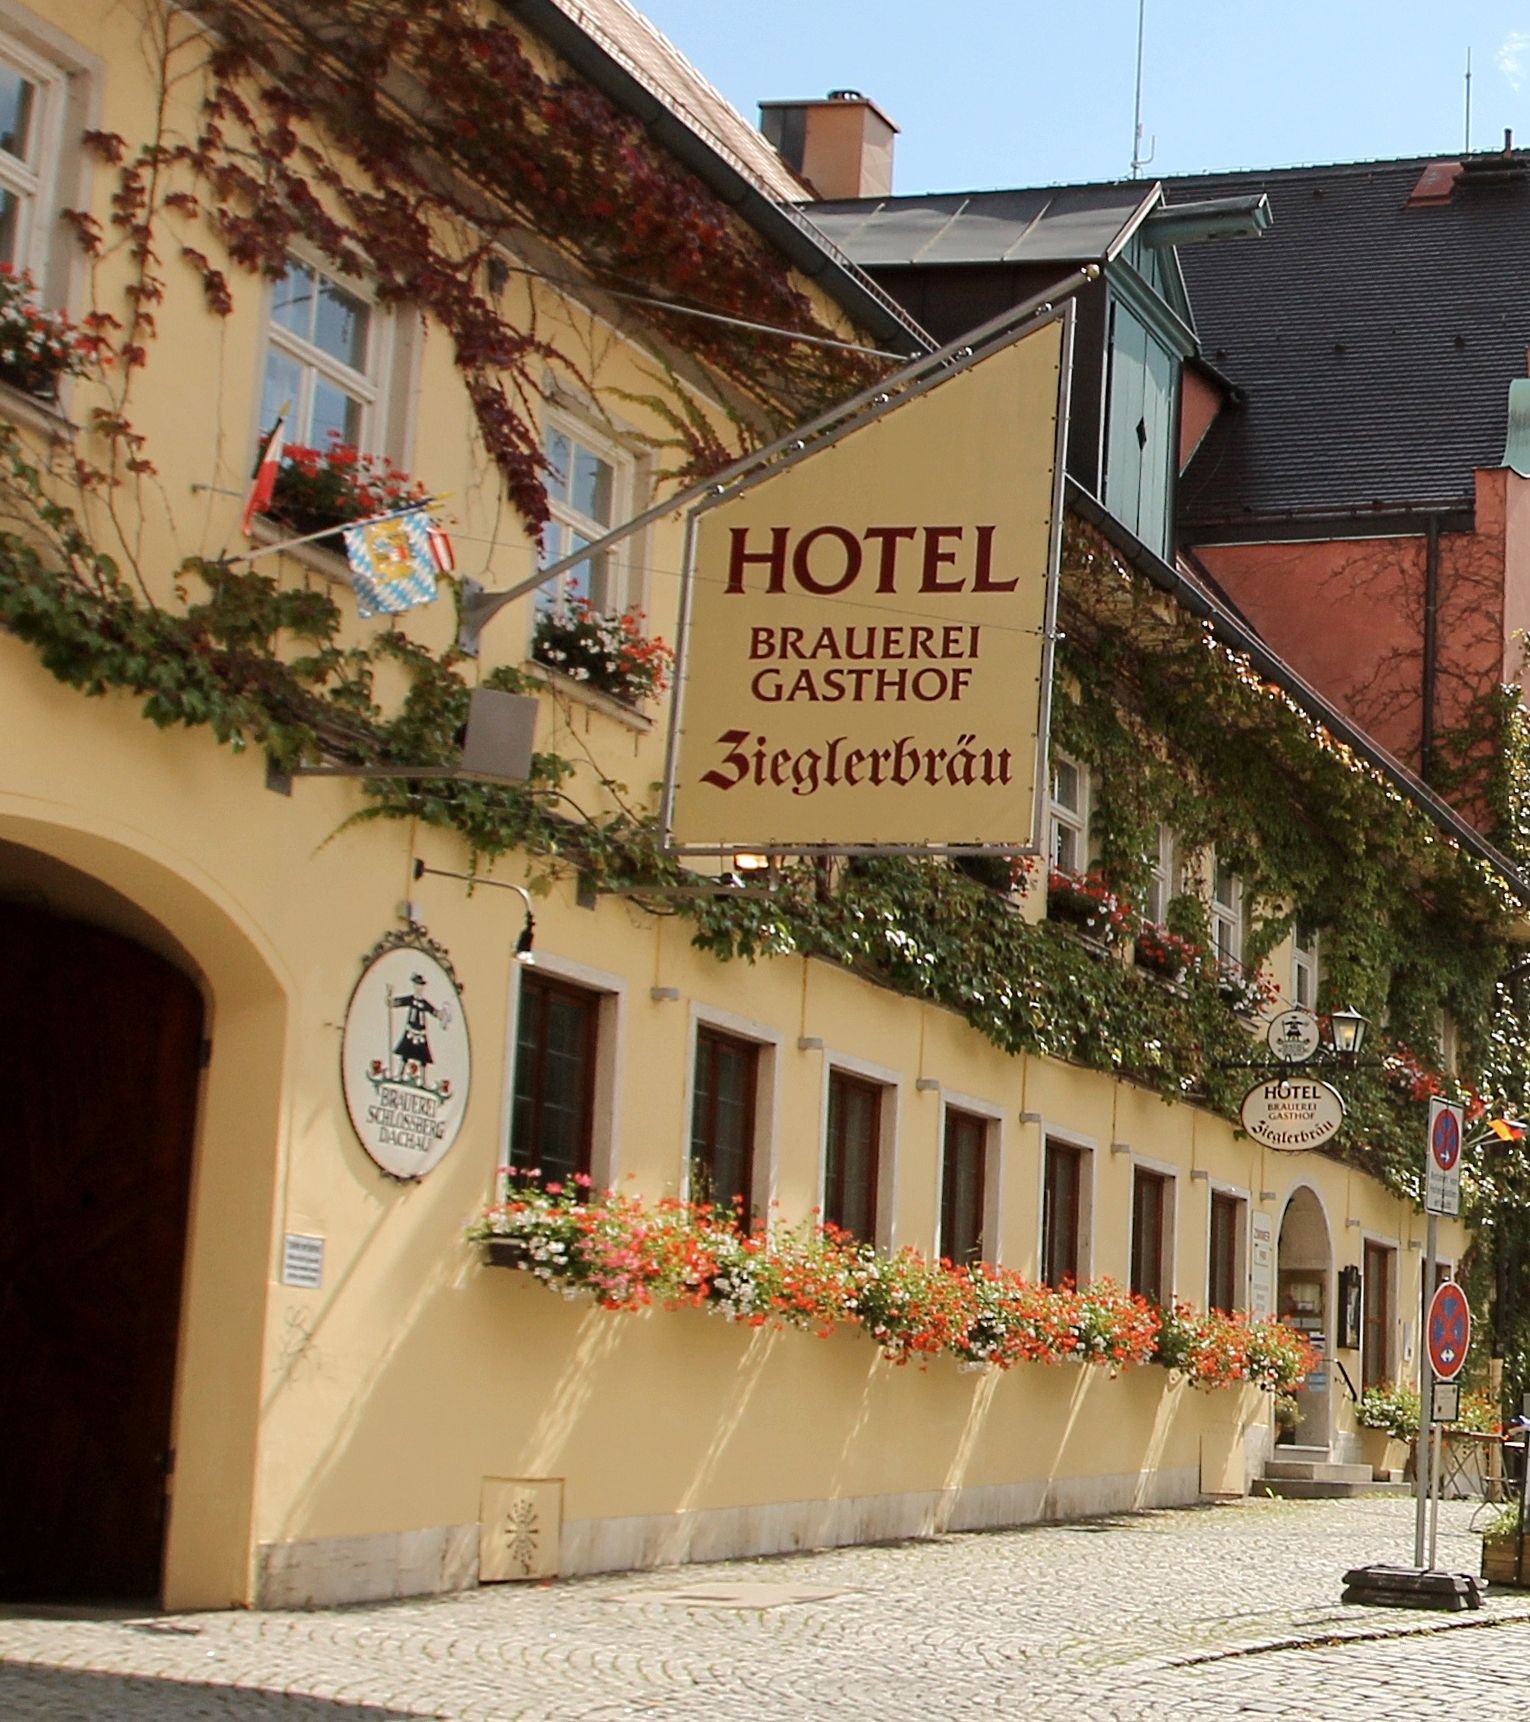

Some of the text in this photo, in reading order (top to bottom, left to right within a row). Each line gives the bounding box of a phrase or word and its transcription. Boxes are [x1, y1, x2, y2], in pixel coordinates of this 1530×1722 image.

[723, 525, 1020, 595] HOTEL
[748, 625, 980, 660] BRAUEREI
[751, 667, 973, 702] GASTHOF
[699, 729, 1013, 797] Zieglerbräu
[381, 1087, 437, 1118] BRAUEREI
[1264, 1085, 1322, 1100] HOTEL
[1267, 1102, 1317, 1111] BRAUEREI
[1268, 1111, 1316, 1120] GASTHOF
[1251, 1119, 1334, 1145] Zieglerbräu
